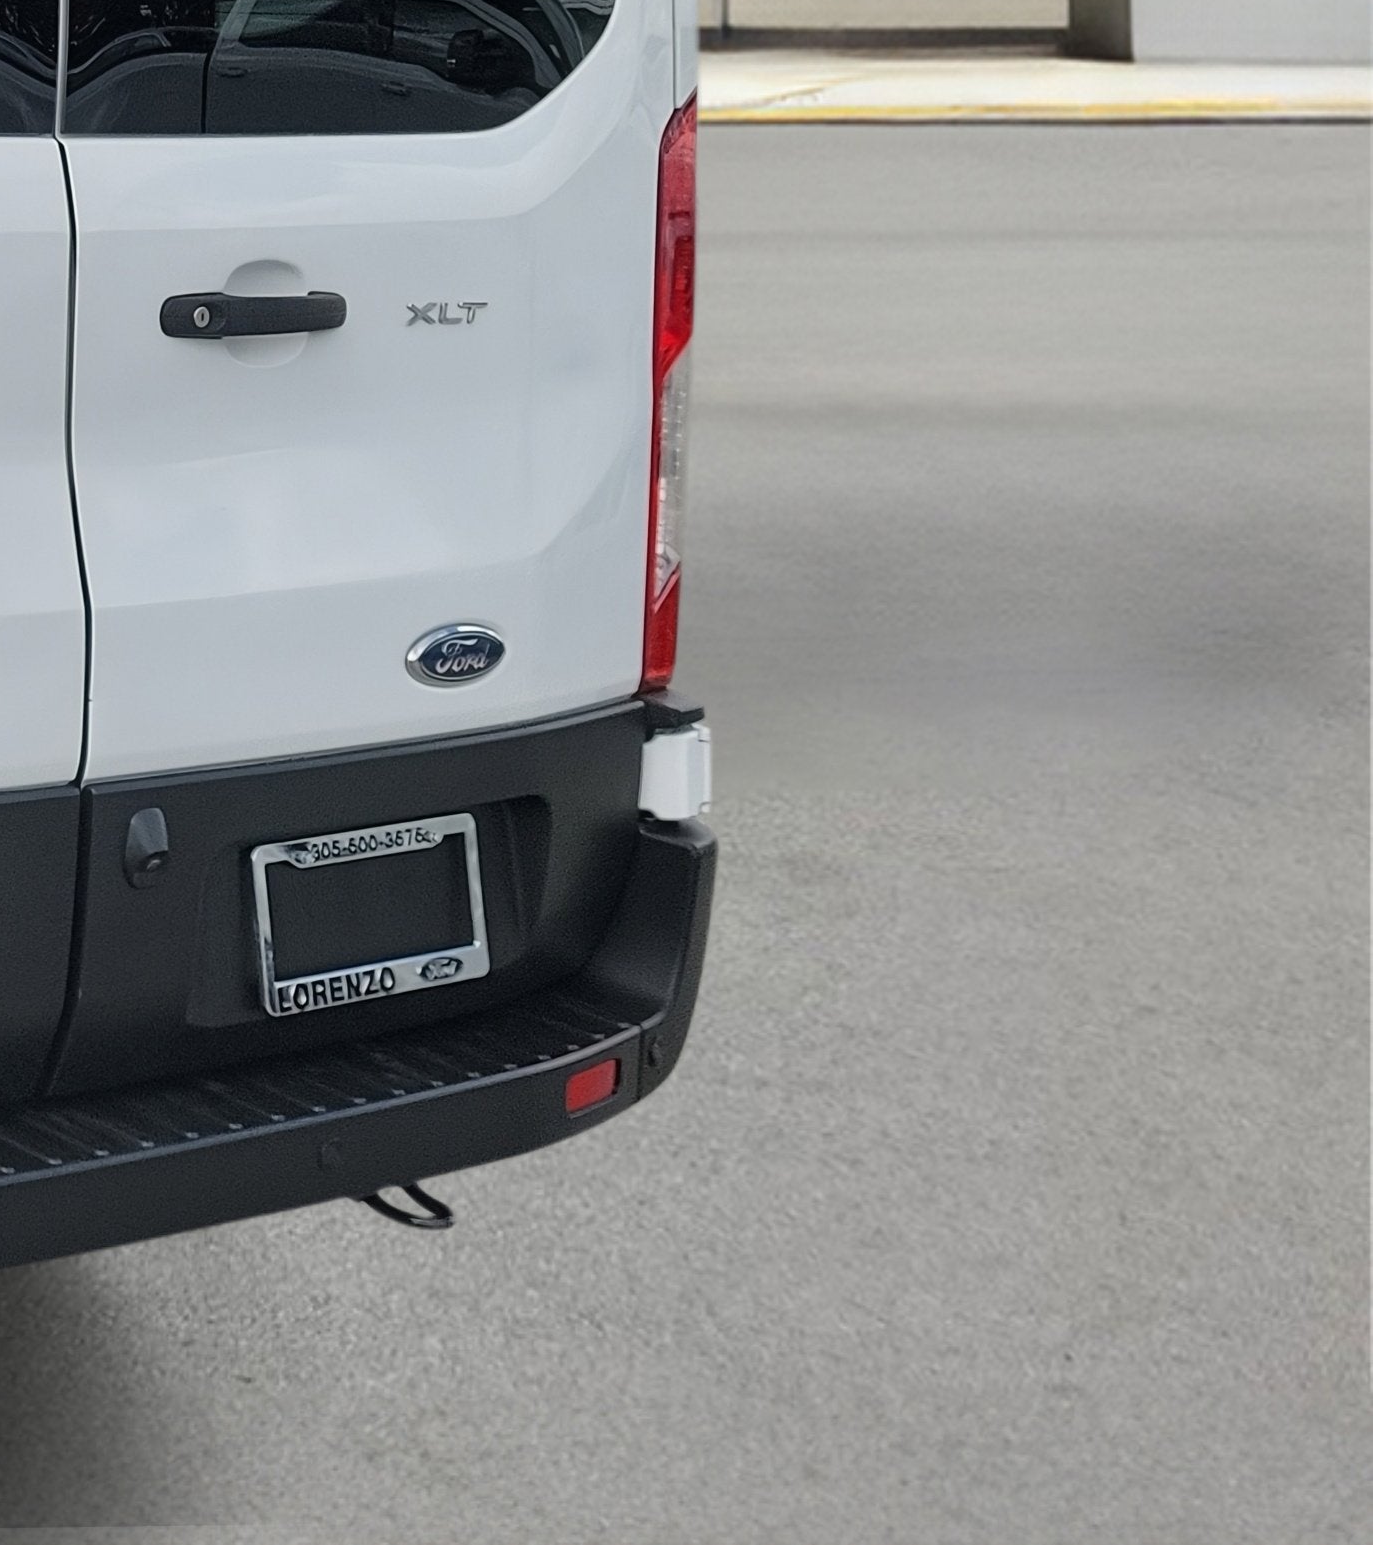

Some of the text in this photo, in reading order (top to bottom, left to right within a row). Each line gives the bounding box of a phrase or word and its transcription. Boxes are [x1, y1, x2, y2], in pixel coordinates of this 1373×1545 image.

[405, 302, 488, 326] XLT
[436, 639, 490, 673] Ford
[277, 967, 395, 1013] LORENZO
